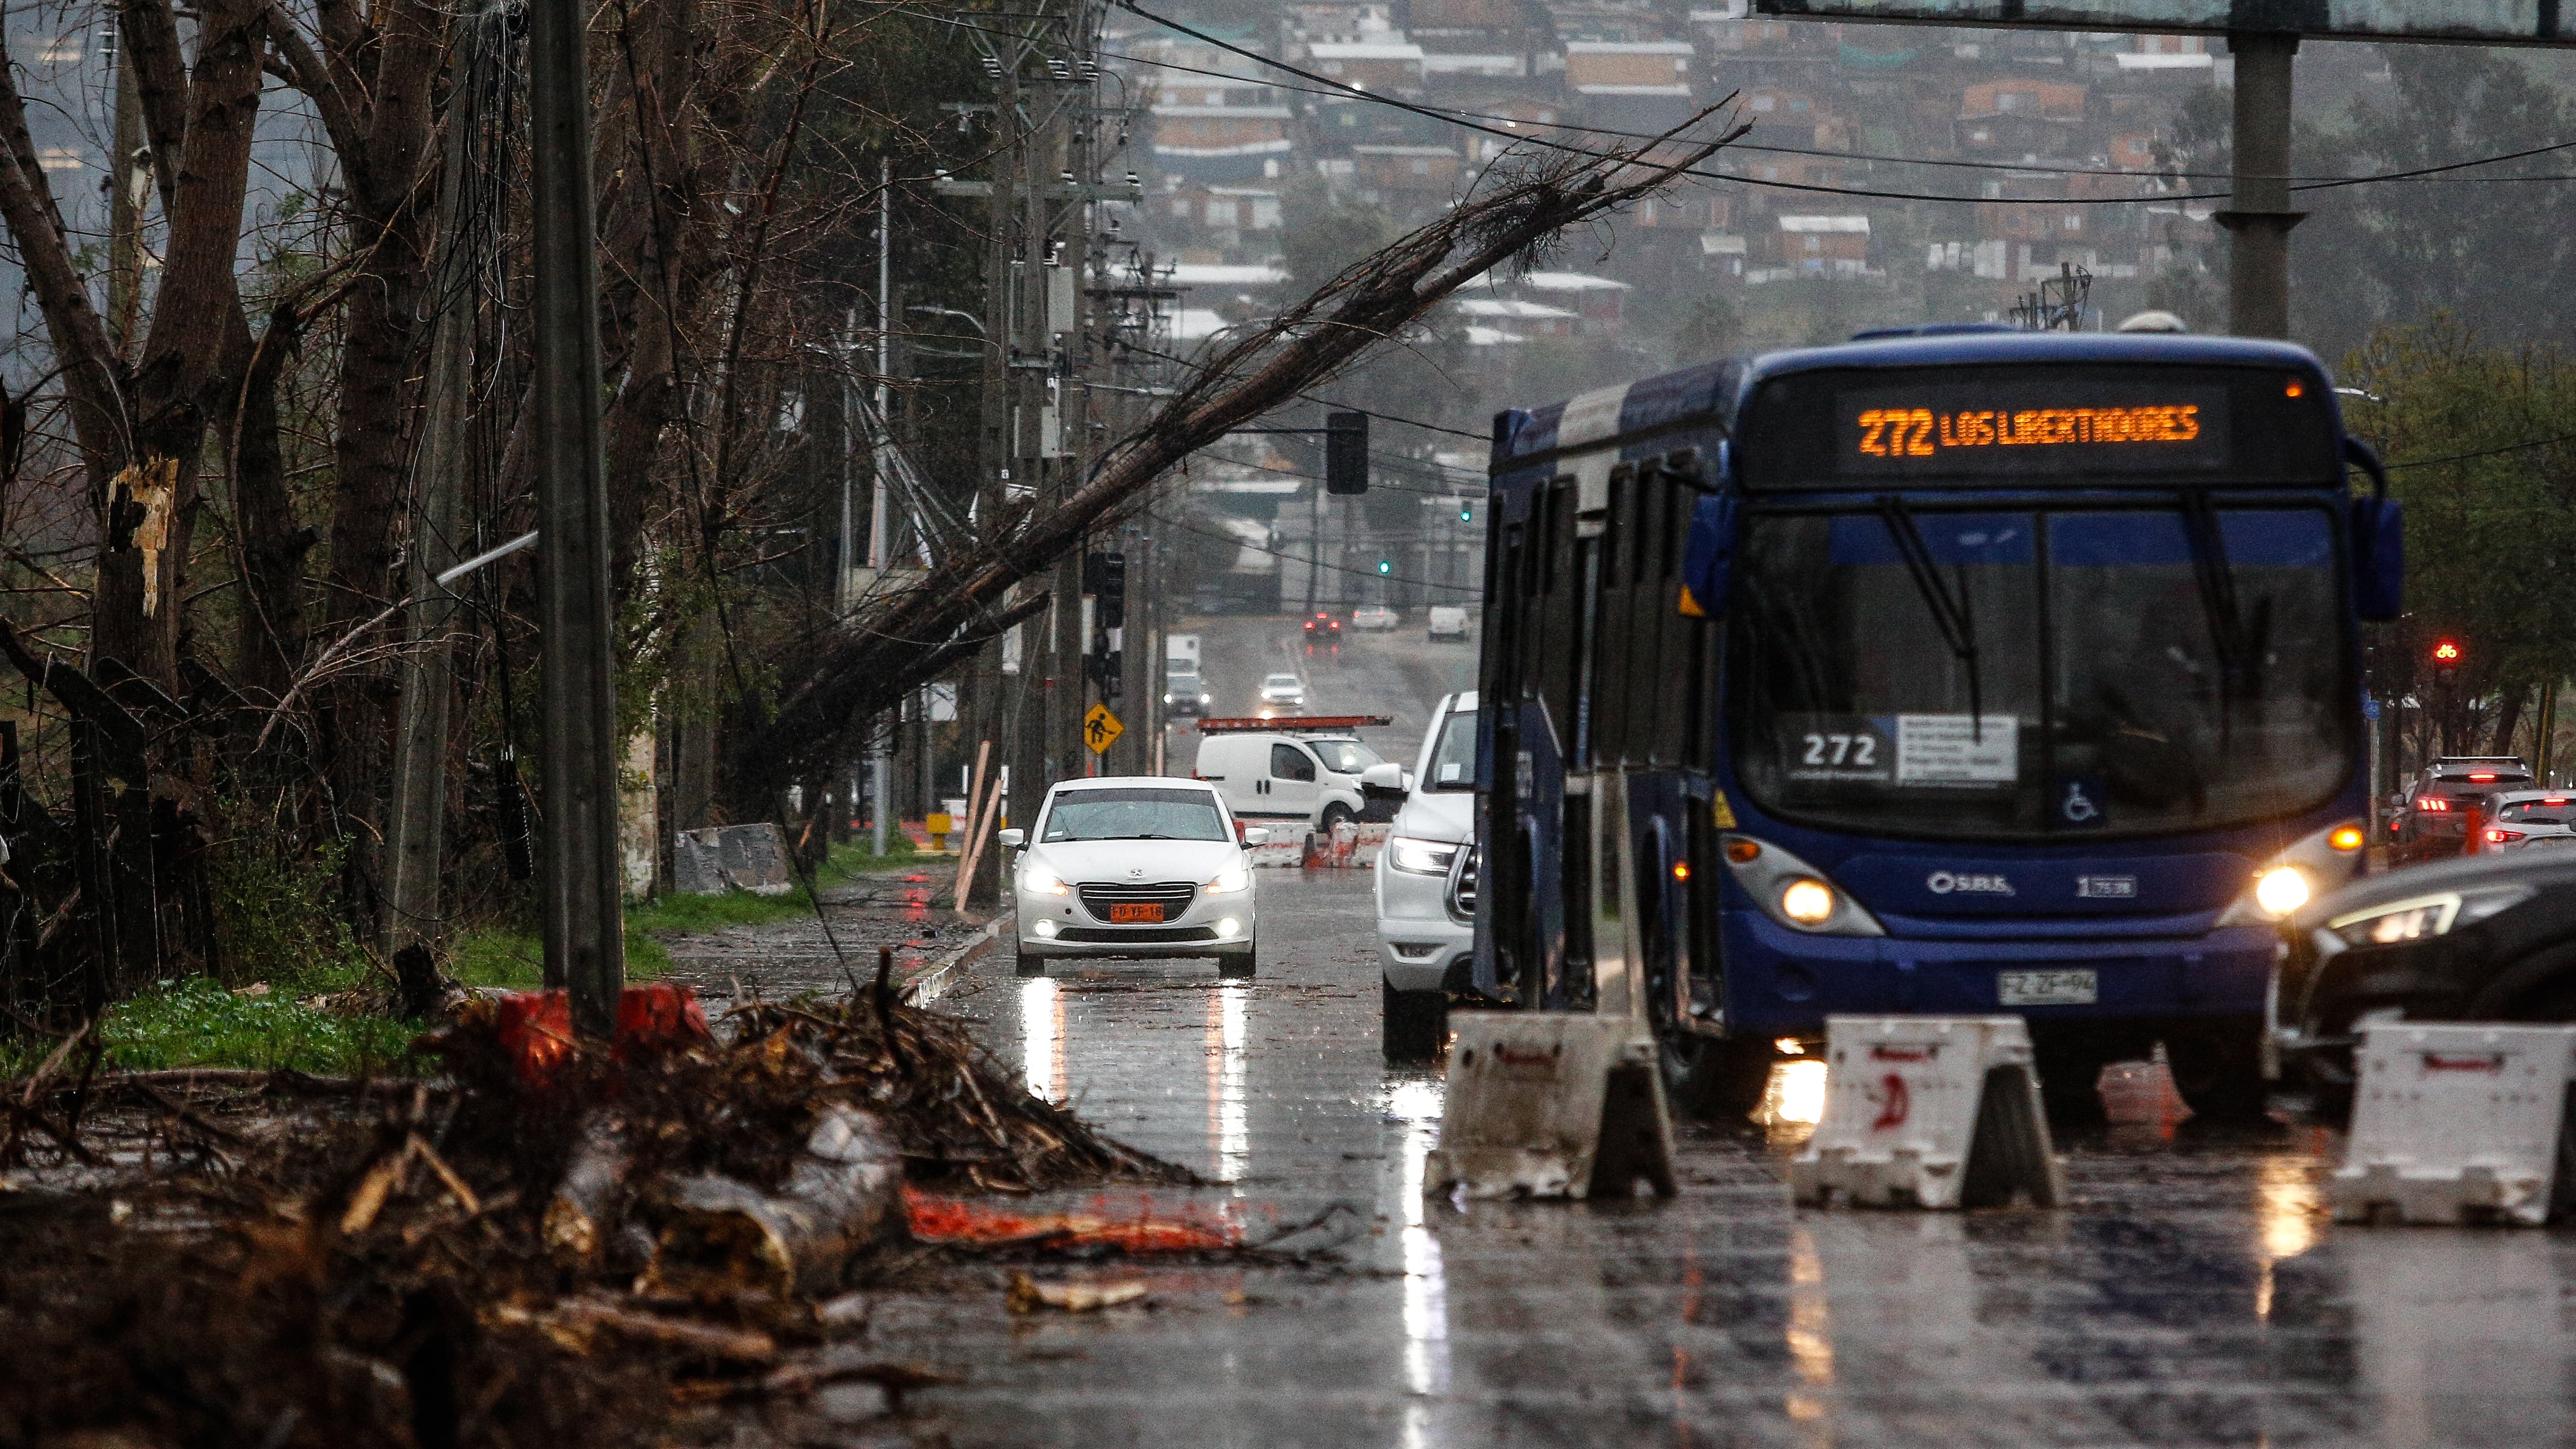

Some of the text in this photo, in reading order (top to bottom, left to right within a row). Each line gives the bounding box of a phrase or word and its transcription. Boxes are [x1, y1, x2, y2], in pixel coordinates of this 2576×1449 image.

[1859, 408, 1934, 456] 272
[1940, 411, 1995, 446] LOS
[1804, 734, 1876, 765] 272
